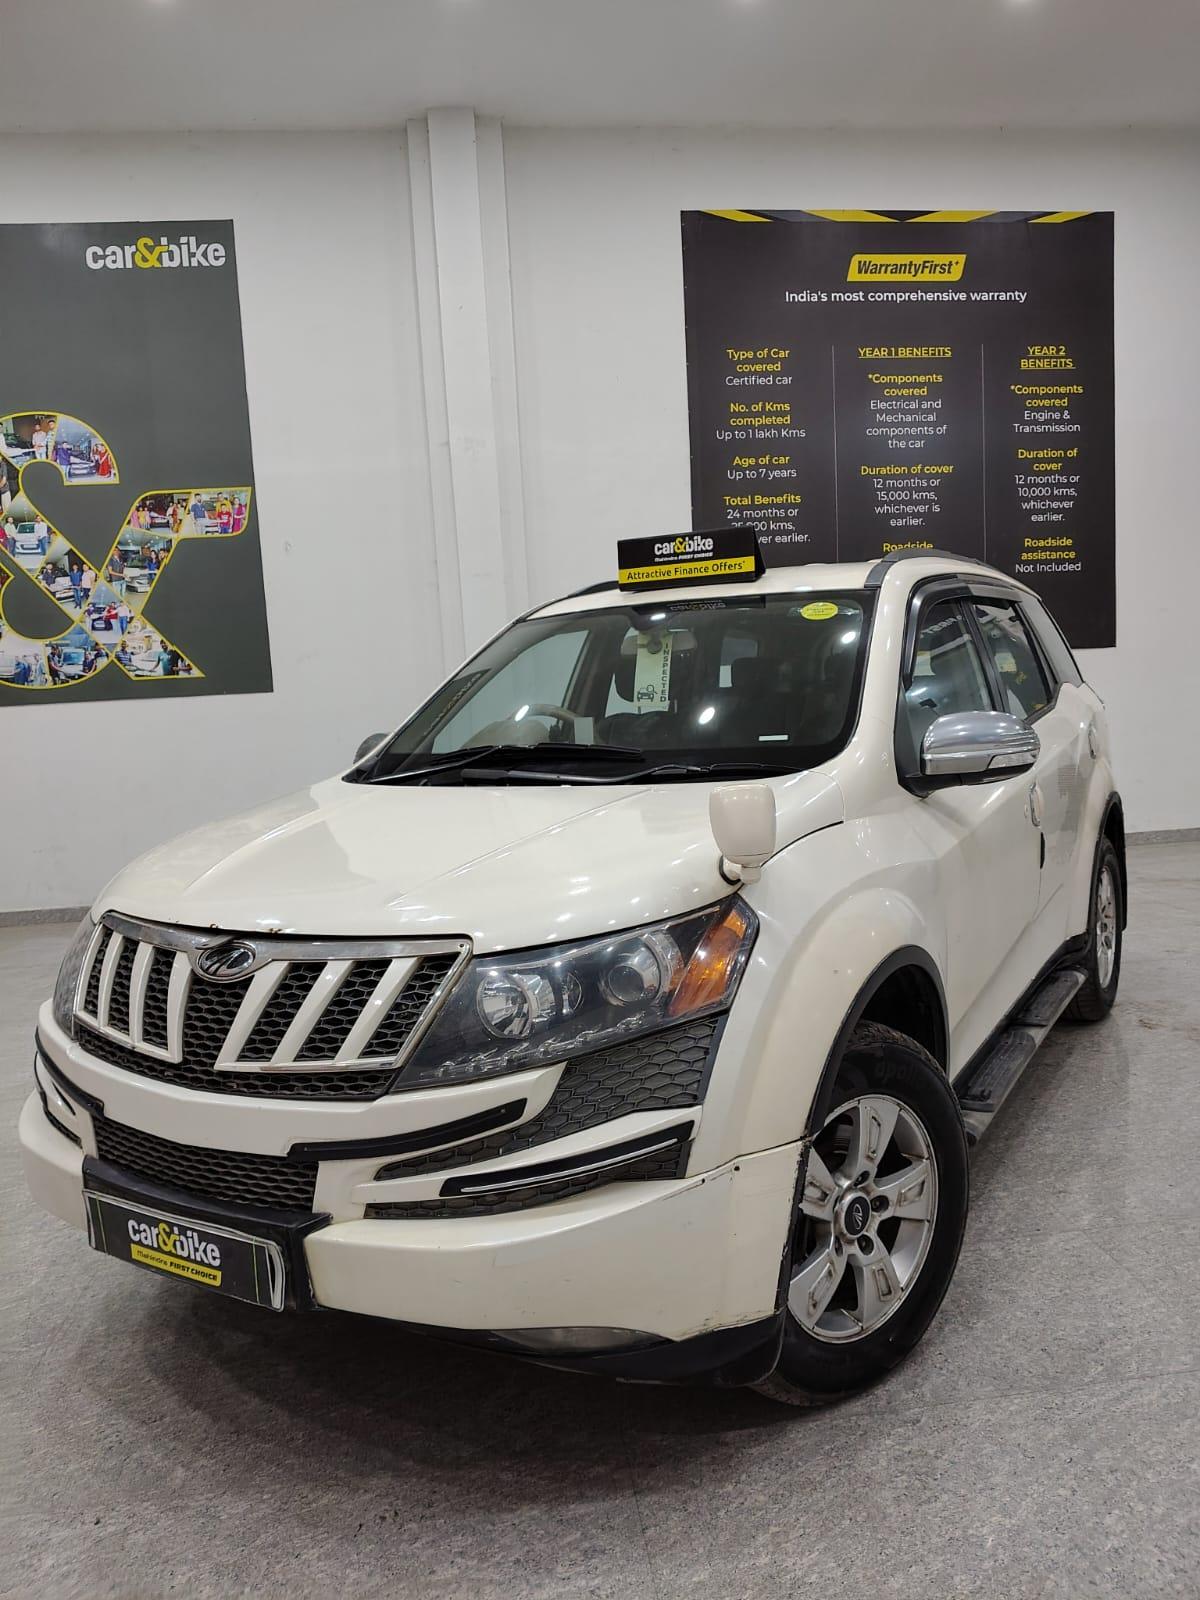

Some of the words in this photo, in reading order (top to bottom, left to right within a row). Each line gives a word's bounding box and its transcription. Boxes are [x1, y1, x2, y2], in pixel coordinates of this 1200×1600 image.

[85, 237, 226, 269] car&bike
[786, 290, 827, 302] India's
[832, 291, 864, 301] most
[868, 290, 966, 303] comprehensive
[970, 291, 1027, 302] warranty
[727, 350, 753, 360] Type
[757, 348, 768, 358] of
[771, 349, 789, 357] Car
[859, 348, 889, 358] YEAR
[889, 347, 897, 358] 1
[898, 347, 952, 358] BENEFITS
[1028, 346, 1057, 356] YEAR
[1059, 346, 1065, 356] 2
[737, 361, 781, 372] covered
[1021, 359, 1074, 369] BENEFITS
[726, 376, 771, 385] Certified
[884, 386, 927, 396] covered
[871, 400, 918, 409] Electrical
[921, 399, 941, 408] and
[1026, 397, 1067, 406] covered
[731, 403, 748, 412] No.
[751, 402, 763, 411] of
[766, 402, 790, 411] Kms
[730, 415, 790, 427] completed
[877, 412, 936, 422] Mechanical
[1025, 410, 1060, 422] Engine
[1063, 410, 1070, 419] &
[866, 427, 933, 437] components
[936, 425, 947, 434] of
[1013, 423, 1080, 432] Transmission
[717, 430, 731, 441] Up
[748, 429, 752, 438] 1
[756, 428, 778, 438] lakh
[782, 428, 805, 437] Kms
[888, 439, 906, 448] the
[909, 440, 925, 448] car
[1018, 448, 1064, 458] Duration
[1067, 448, 1078, 457] of
[733, 457, 755, 467] Age
[759, 455, 770, 464] of
[728, 470, 743, 480] Up
[746, 470, 757, 478] to
[759, 469, 766, 477] 7
[768, 470, 796, 480] years
[861, 465, 908, 475] Duration
[911, 464, 921, 473] of
[923, 464, 953, 473] cover
[873, 479, 883, 488] 12
[886, 477, 927, 487] months
[1015, 475, 1024, 484] 12
[1028, 474, 1068, 484] months
[876, 491, 910, 502] 15,000
[913, 491, 937, 500] kms,
[1018, 487, 1051, 497] 10,000
[1054, 487, 1077, 496] kms,
[724, 496, 751, 505] Total
[755, 494, 801, 504] Benefits
[1021, 500, 1073, 509] whichever
[727, 509, 740, 518] 24
[743, 508, 785, 518] months
[875, 504, 929, 513] whichever
[932, 503, 940, 512] is
[890, 516, 925, 526] earlier.
[1031, 512, 1065, 521] earlier.
[770, 521, 795, 530] kms,
[775, 533, 810, 542] earlier.
[1025, 537, 1072, 547] Roadside
[655, 536, 713, 555] car&bike
[1022, 550, 1075, 560] assistance
[1016, 564, 1034, 572] Not
[1037, 562, 1081, 571] Included
[628, 568, 671, 580] Attractive
[675, 566, 709, 575] Finance
[660, 643, 670, 702] INSPECTED
[127, 1219, 221, 1266] car&bike
[169, 1262, 189, 1272] FIRST
[191, 1268, 217, 1281] CHOICE
